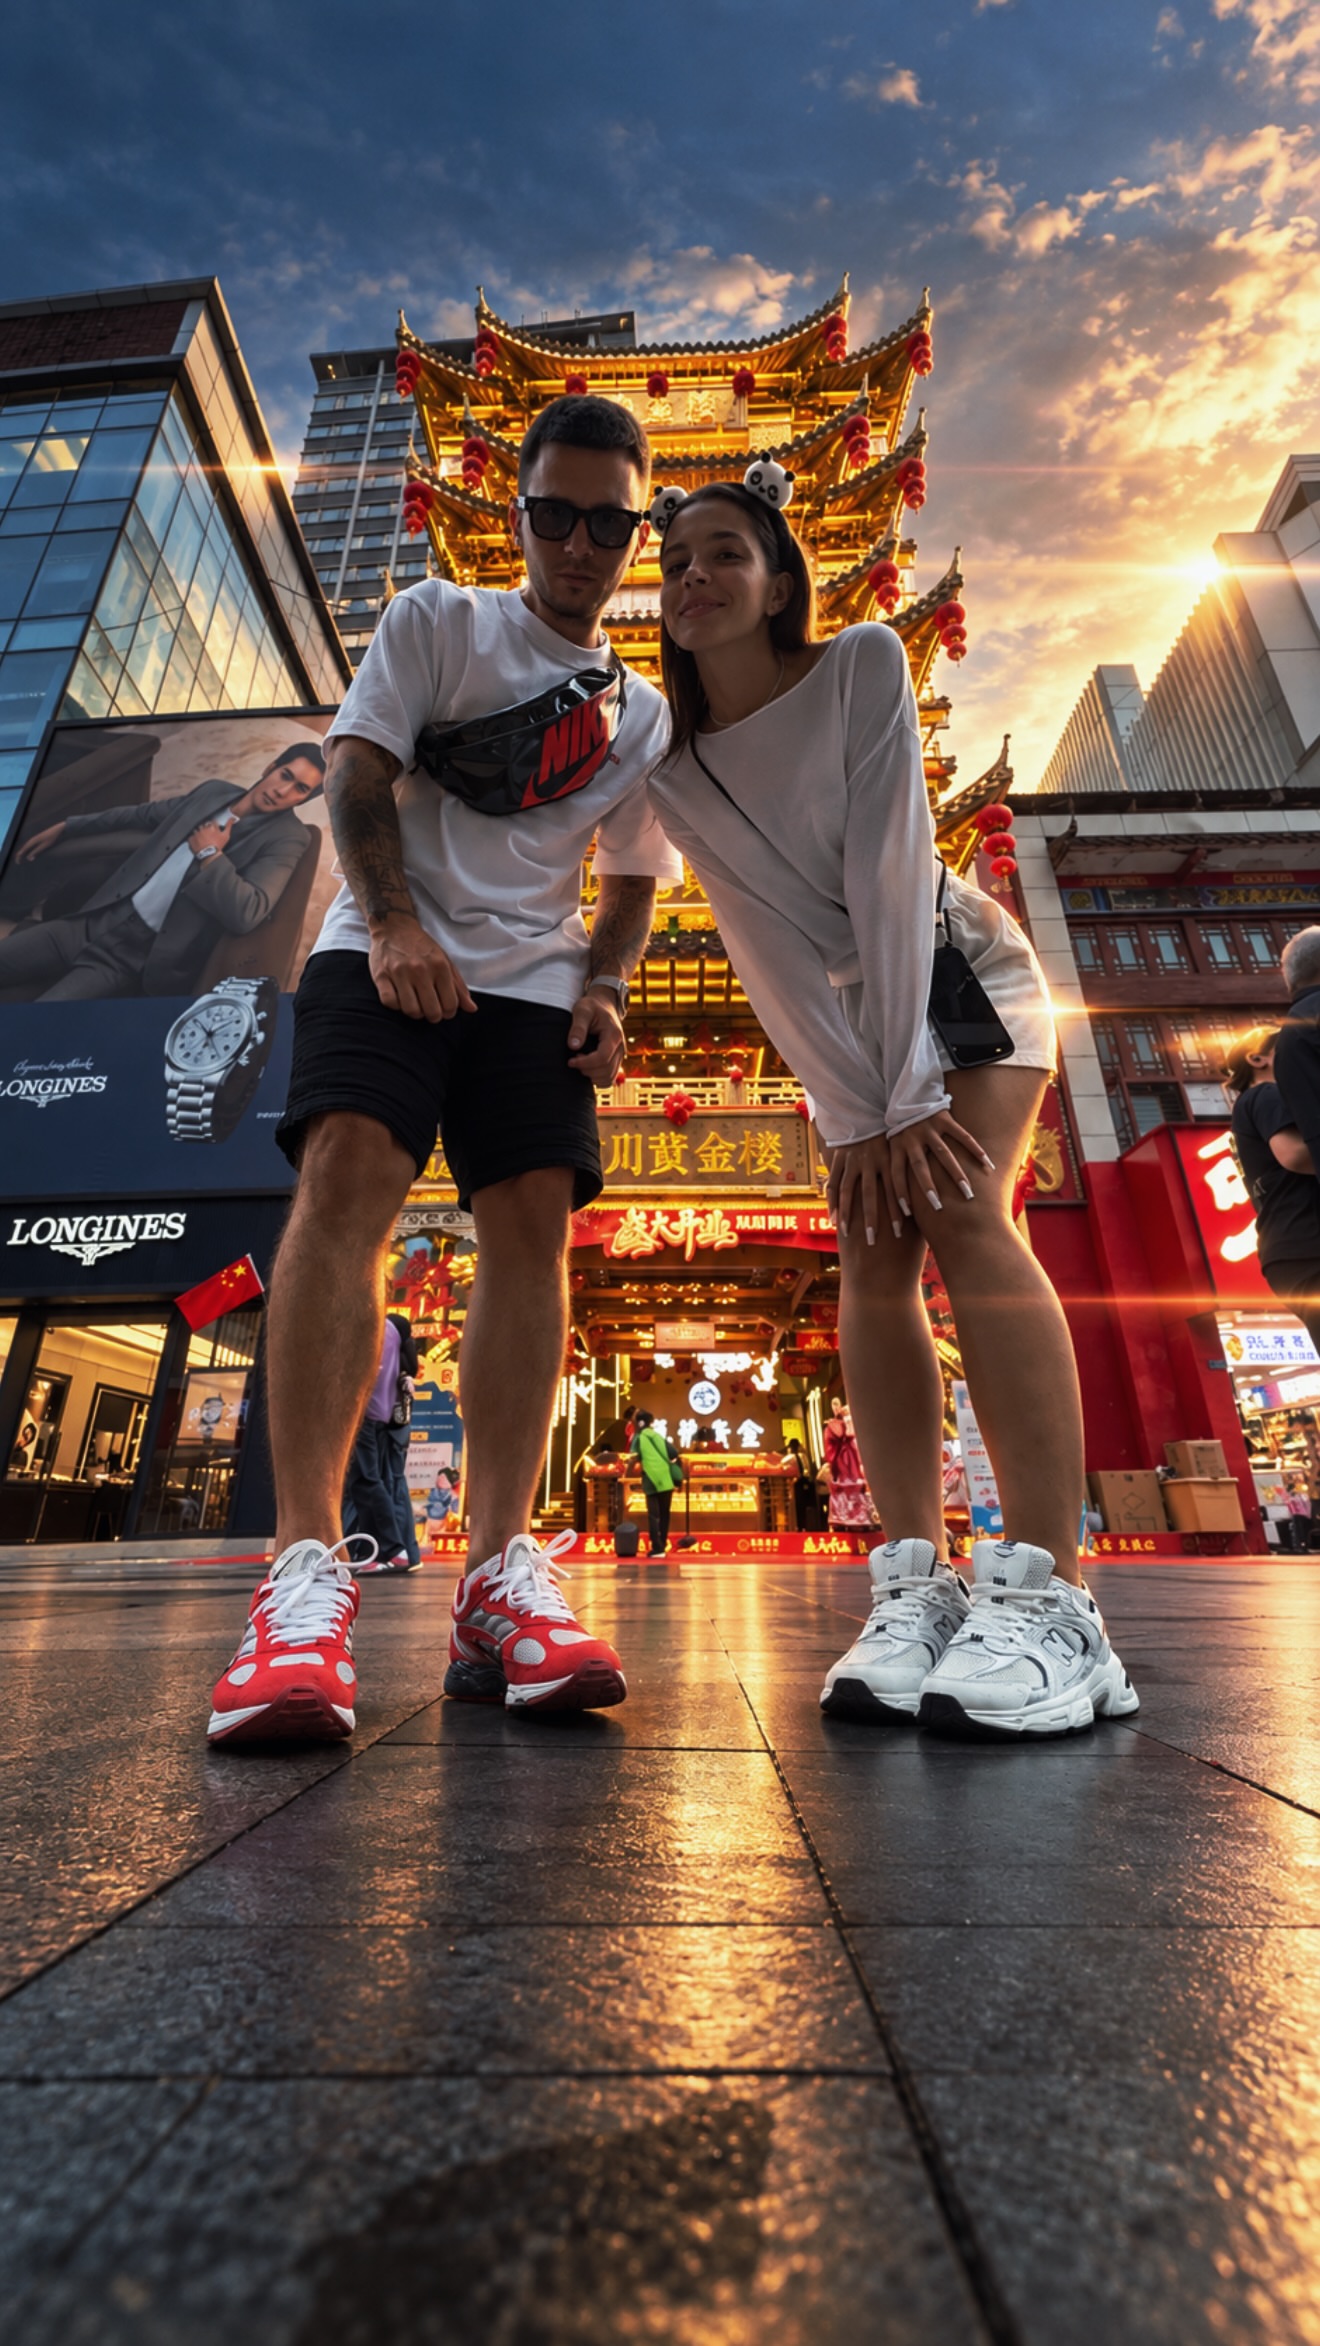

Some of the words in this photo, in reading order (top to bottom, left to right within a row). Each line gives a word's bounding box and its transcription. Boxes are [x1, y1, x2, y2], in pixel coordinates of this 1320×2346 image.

[537, 694, 608, 786] NIK
[600, 1130, 783, 1176] 川黄金楼
[6, 1212, 187, 1246] LONGINES
